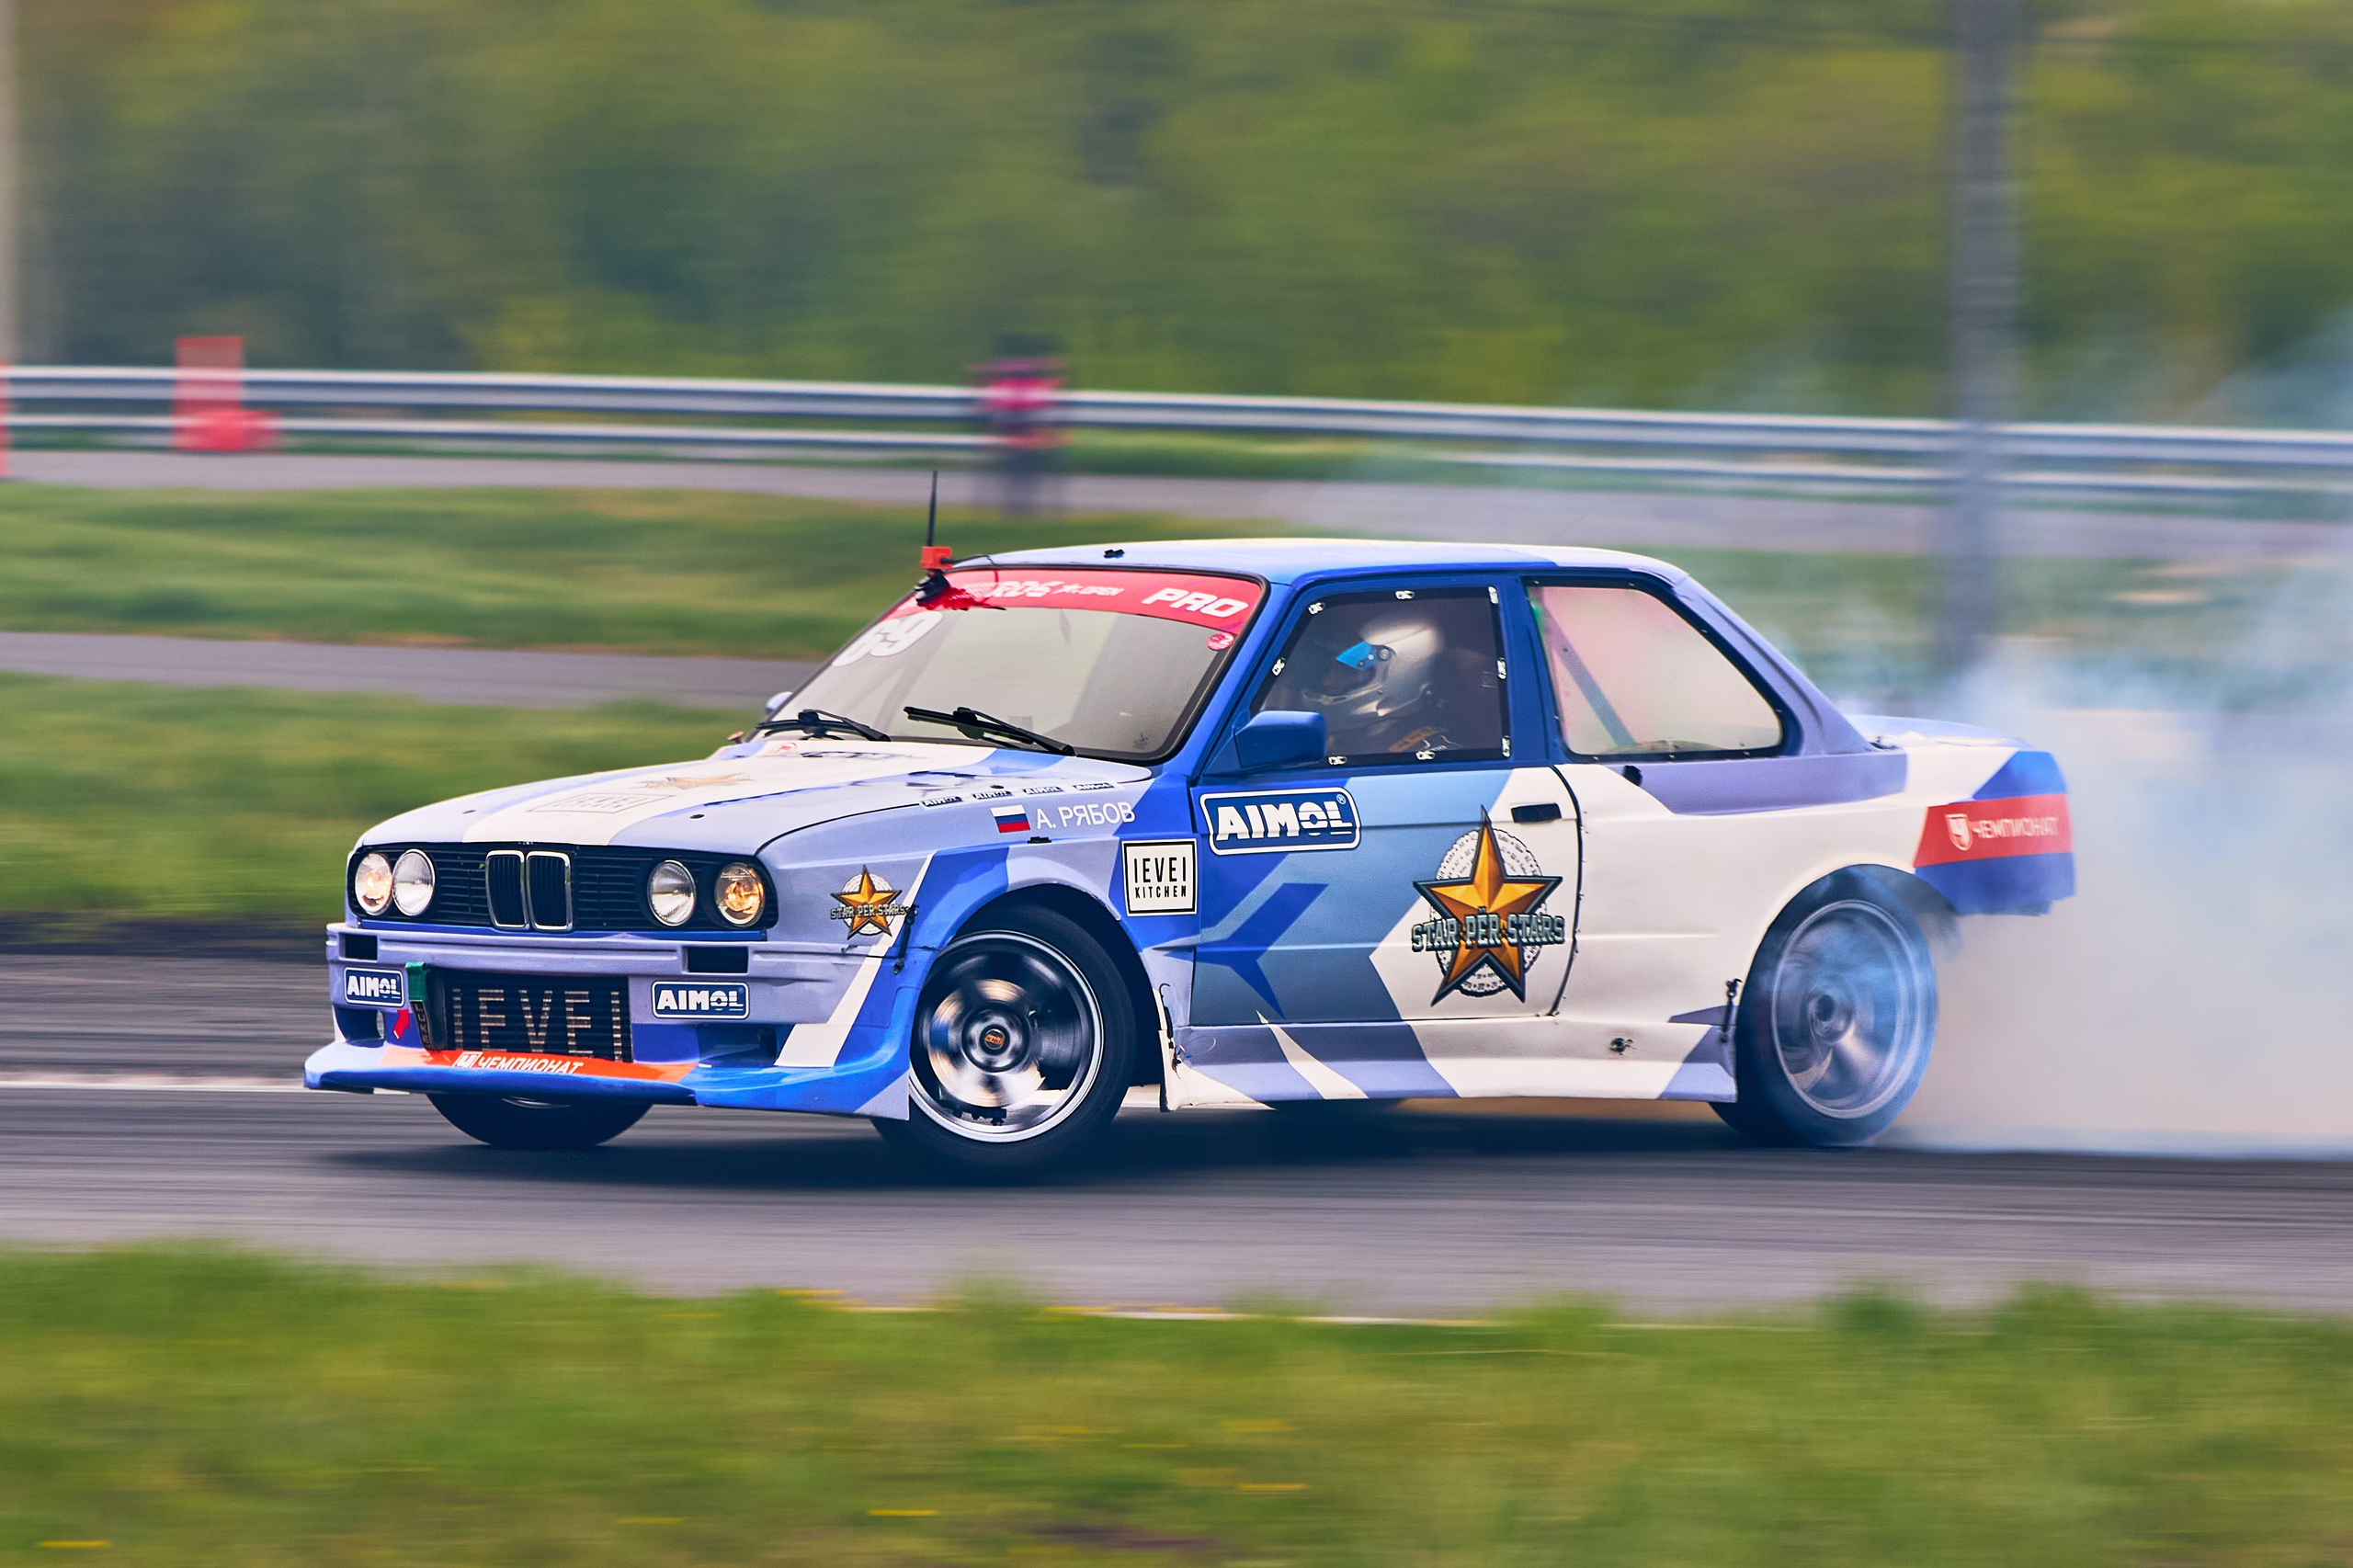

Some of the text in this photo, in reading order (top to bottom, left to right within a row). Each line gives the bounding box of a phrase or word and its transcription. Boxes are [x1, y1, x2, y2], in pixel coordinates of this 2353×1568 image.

[1141, 587, 1249, 618] PRO
[1037, 801, 1136, 830] А. РЯБОВ
[1215, 800, 1353, 841] AIMOL
[1134, 885, 1187, 899] KITCHEN
[830, 904, 855, 920] STAR
[878, 903, 906, 916] STARS
[1412, 917, 1461, 952] STAR
[1506, 914, 1565, 947] STARS
[347, 975, 401, 999] AIMOL
[656, 989, 745, 1011] AIMOL
[478, 1056, 585, 1074] ЧЕМПИОНАТ
